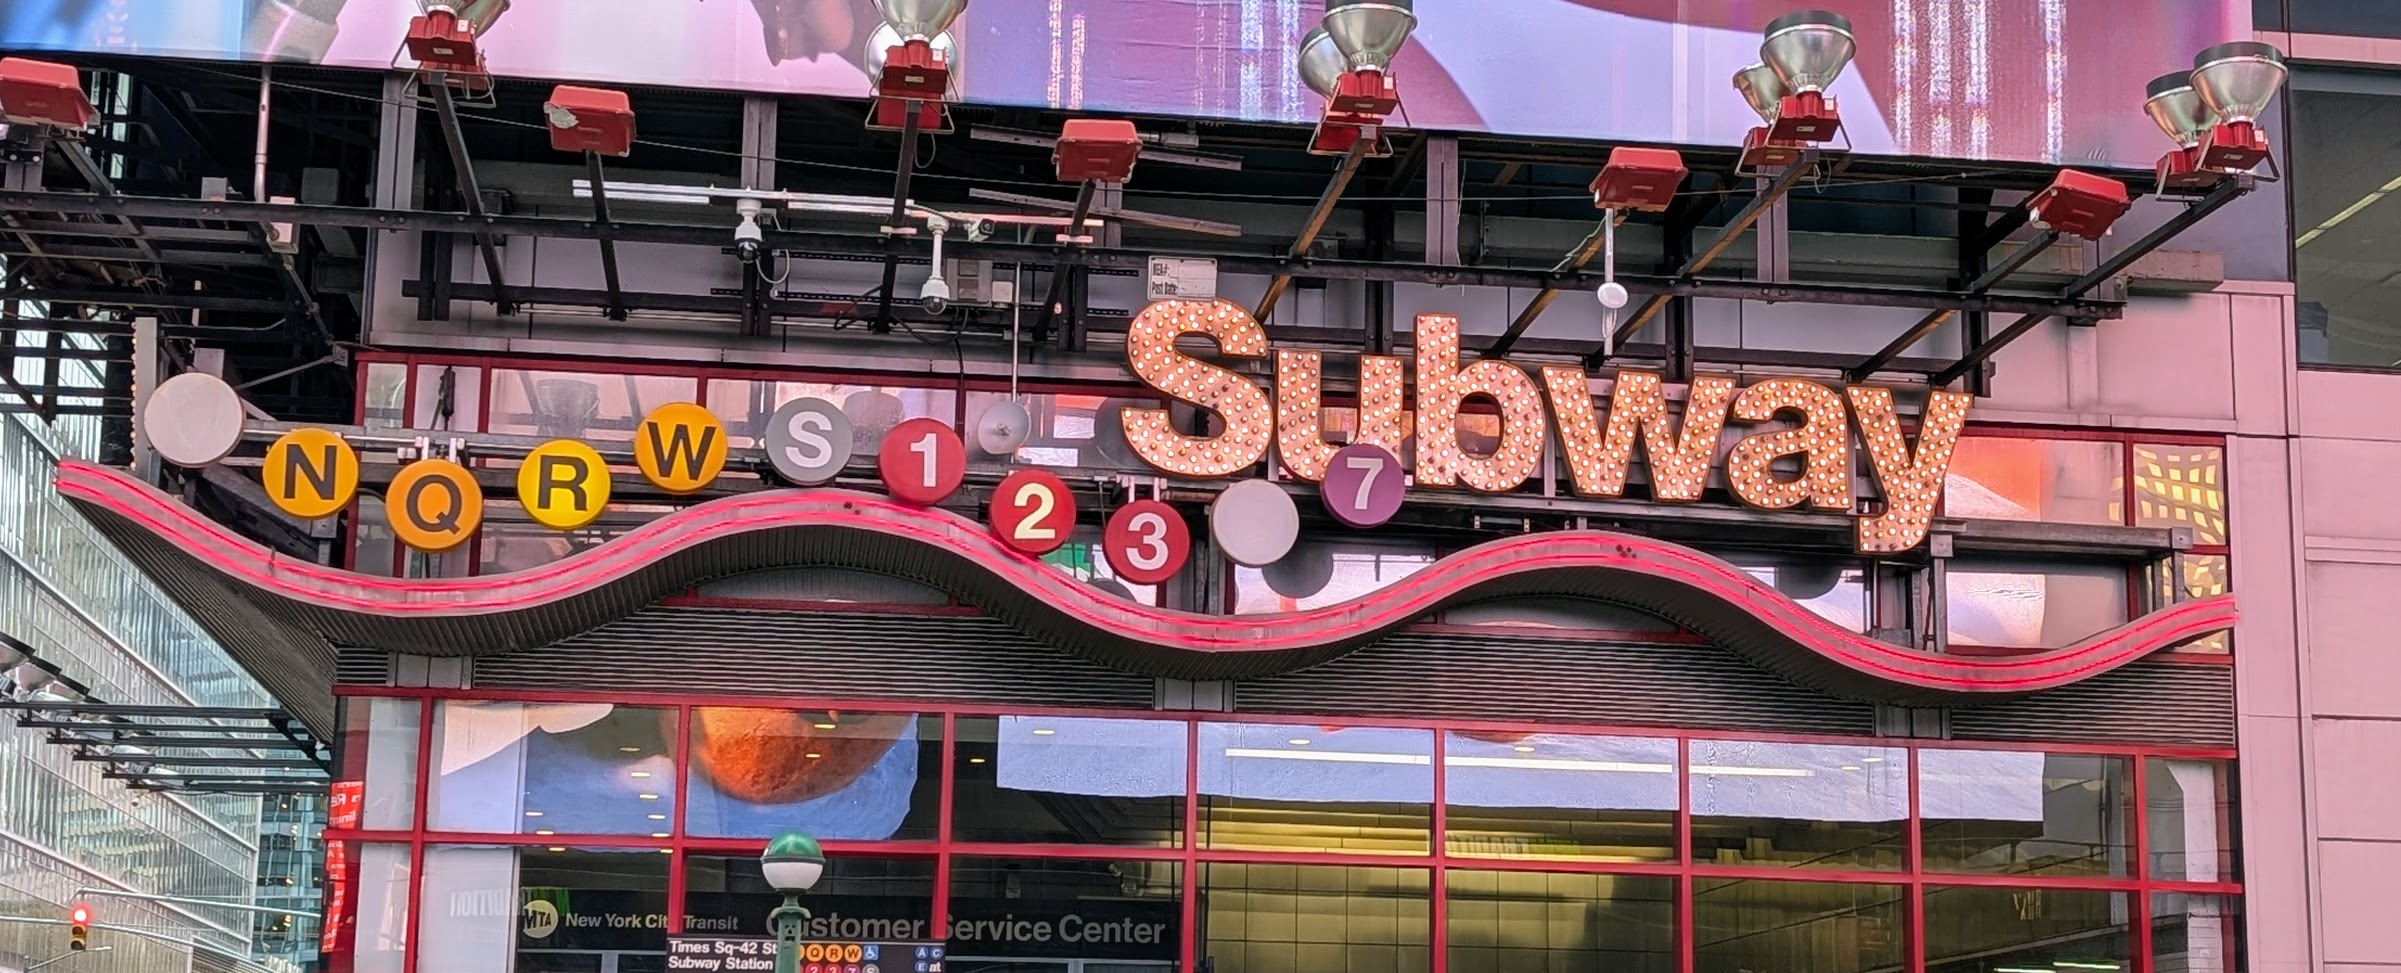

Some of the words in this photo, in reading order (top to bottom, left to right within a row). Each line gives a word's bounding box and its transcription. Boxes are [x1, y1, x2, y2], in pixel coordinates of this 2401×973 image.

[1121, 298, 1974, 552] Subway
[283, 443, 338, 500] N
[406, 473, 461, 536] Q
[537, 455, 589, 511] R
[646, 421, 717, 482] W
[785, 411, 832, 468] S
[1012, 483, 1056, 540] 2
[1125, 512, 1170, 570] 3
[1346, 457, 1384, 510] 7
[523, 908, 552, 930] MTA
[565, 912, 601, 928] New
[605, 913, 642, 928] York
[645, 913, 668, 928] Cit
[683, 915, 738, 930] Transit
[1059, 914, 1166, 944] Center
[669, 941, 710, 953] Times
[714, 941, 758, 956] Sq-42
[762, 942, 778, 955] St
[668, 956, 721, 971] Subway
[725, 957, 774, 970] Station
[928, 962, 941, 972] at
